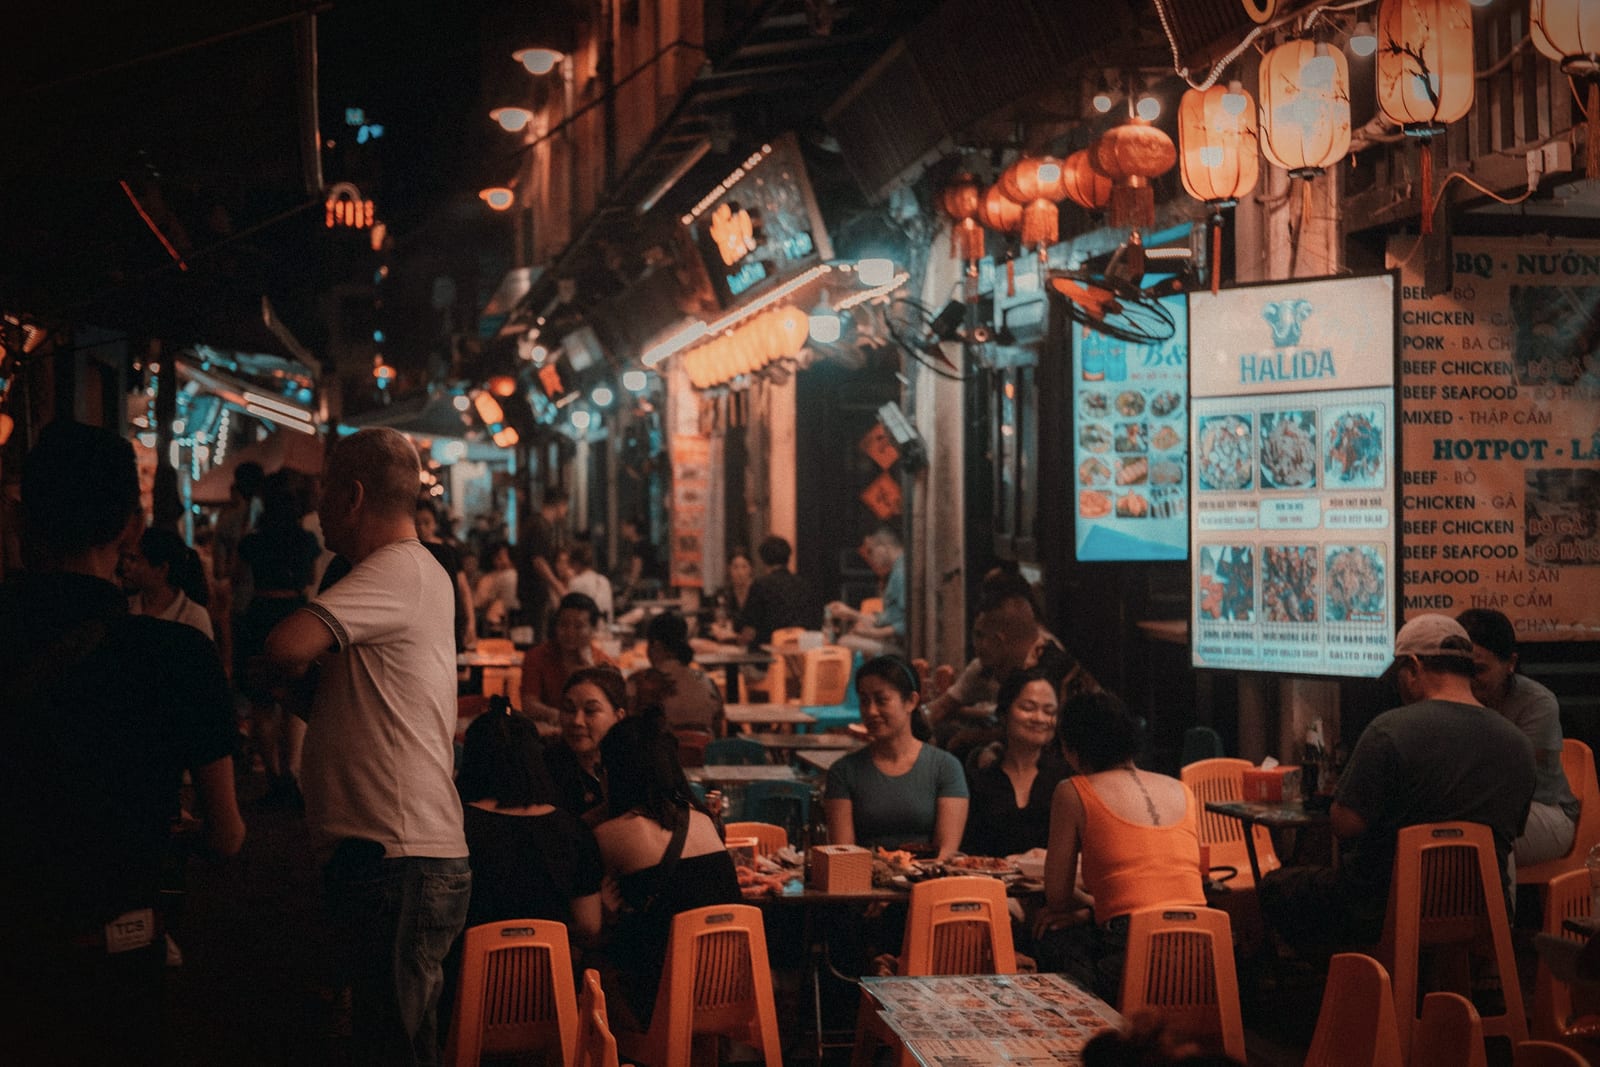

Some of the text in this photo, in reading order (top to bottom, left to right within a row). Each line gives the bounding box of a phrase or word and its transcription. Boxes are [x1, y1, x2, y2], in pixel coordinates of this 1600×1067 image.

[1454, 252, 1493, 279] BQ
[1403, 286, 1432, 300] BEE
[1402, 312, 1475, 326] CHICKEN
[1403, 336, 1445, 350] PORK
[1462, 337, 1481, 350] BA
[1239, 349, 1336, 385] HALIDA
[1404, 361, 1437, 375] BEEF
[1442, 361, 1513, 375] CHICKEN
[1404, 386, 1437, 400] BEEF
[1442, 386, 1518, 400] SEAFOOD
[1403, 411, 1453, 425] MIXED
[1433, 439, 1548, 461] HOTPOT
[1404, 469, 1476, 485] BEEF BÒ
[1403, 492, 1517, 510] CHICKEN GÀ
[1404, 521, 1437, 534] BEEF
[1443, 521, 1514, 534] CHICKEN
[1404, 546, 1437, 559] BEEF
[1443, 545, 1518, 559] SEAFOOD
[1404, 570, 1479, 584] SEAFOOD
[1404, 595, 1453, 608] MIXED
